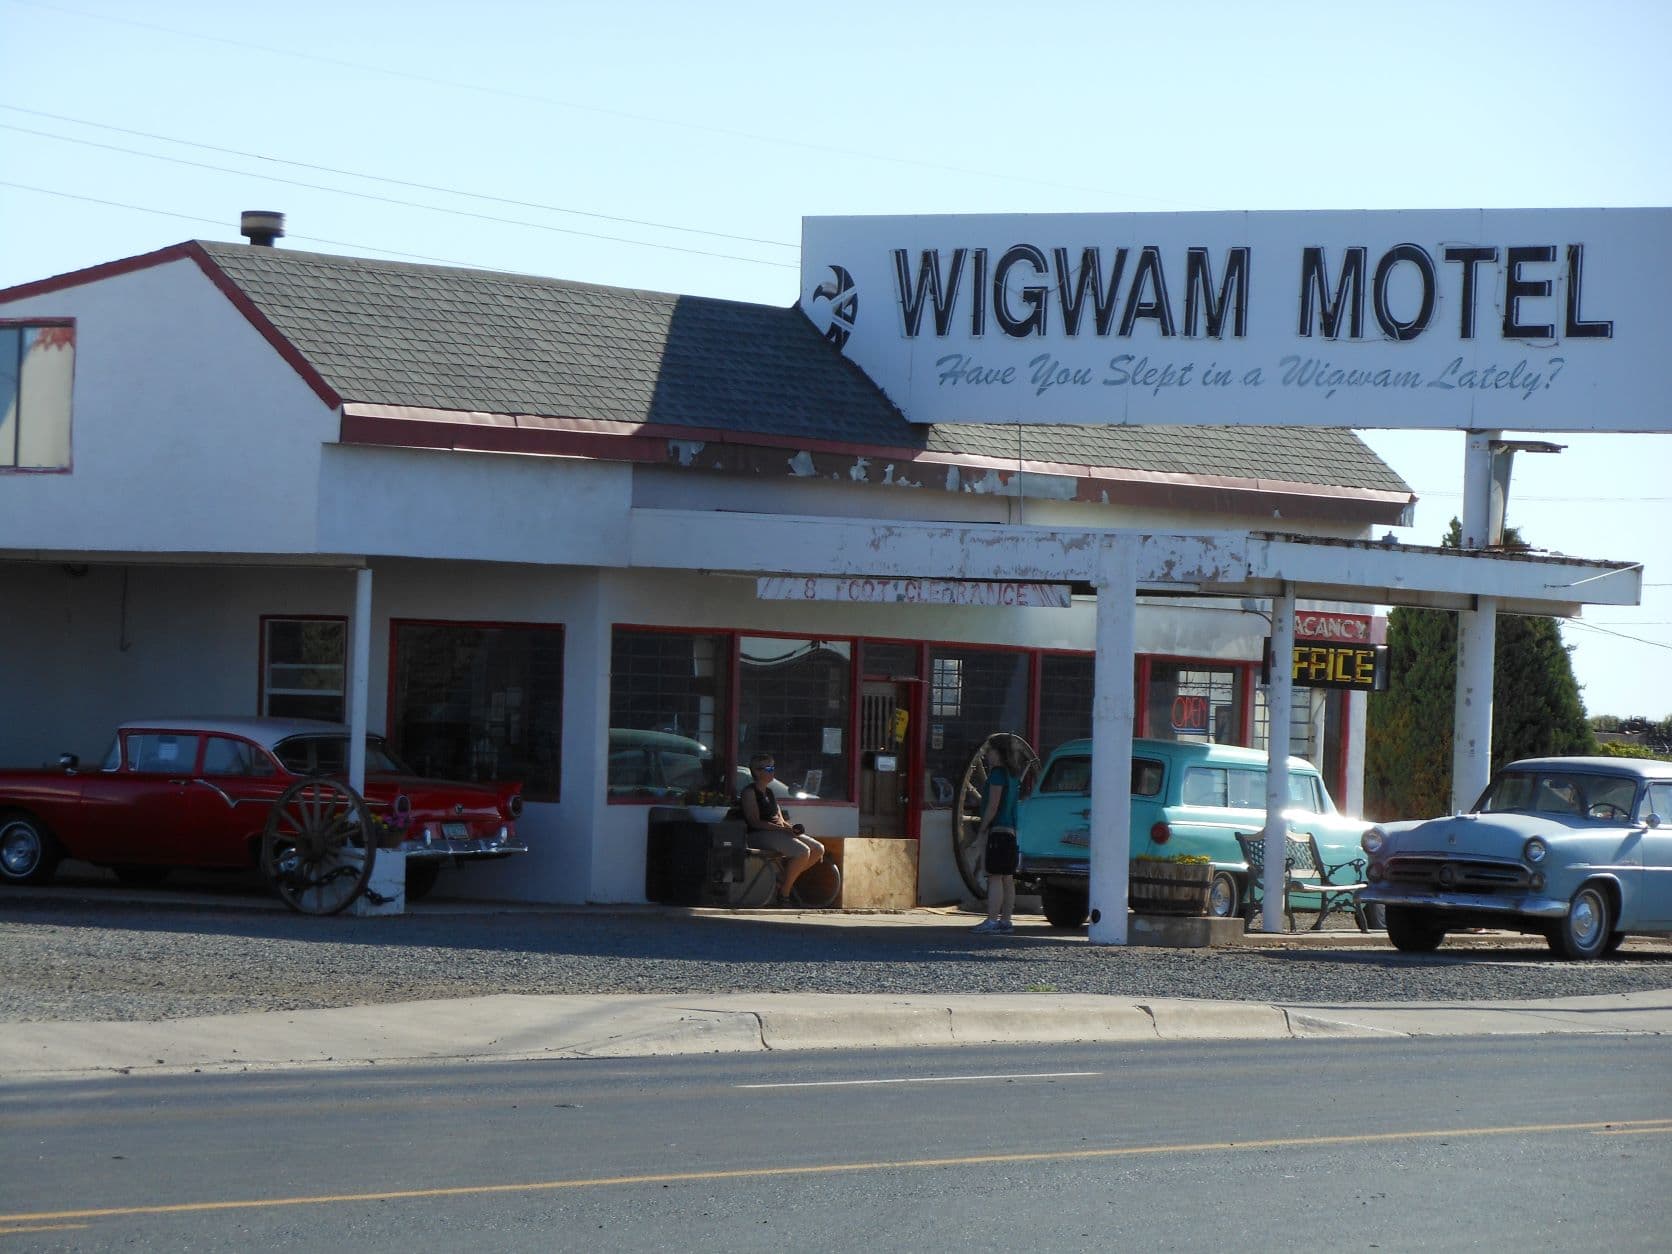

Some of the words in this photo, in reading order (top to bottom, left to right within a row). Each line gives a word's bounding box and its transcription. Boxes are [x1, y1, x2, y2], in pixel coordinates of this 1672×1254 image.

[893, 243, 1251, 338] WIGWAM
[1298, 242, 1614, 341] MOTEL
[936, 353, 1016, 387] Have
[1029, 353, 1092, 396] You
[1103, 354, 1194, 396] Slept
[1202, 361, 1233, 386] in
[1243, 366, 1265, 386] a
[1280, 355, 1423, 399] Wigwam
[1427, 356, 1565, 400] Lately?
[1294, 616, 1368, 639] ACANCY
[1292, 646, 1375, 684] FFICE
[1171, 696, 1208, 728] OPEN
